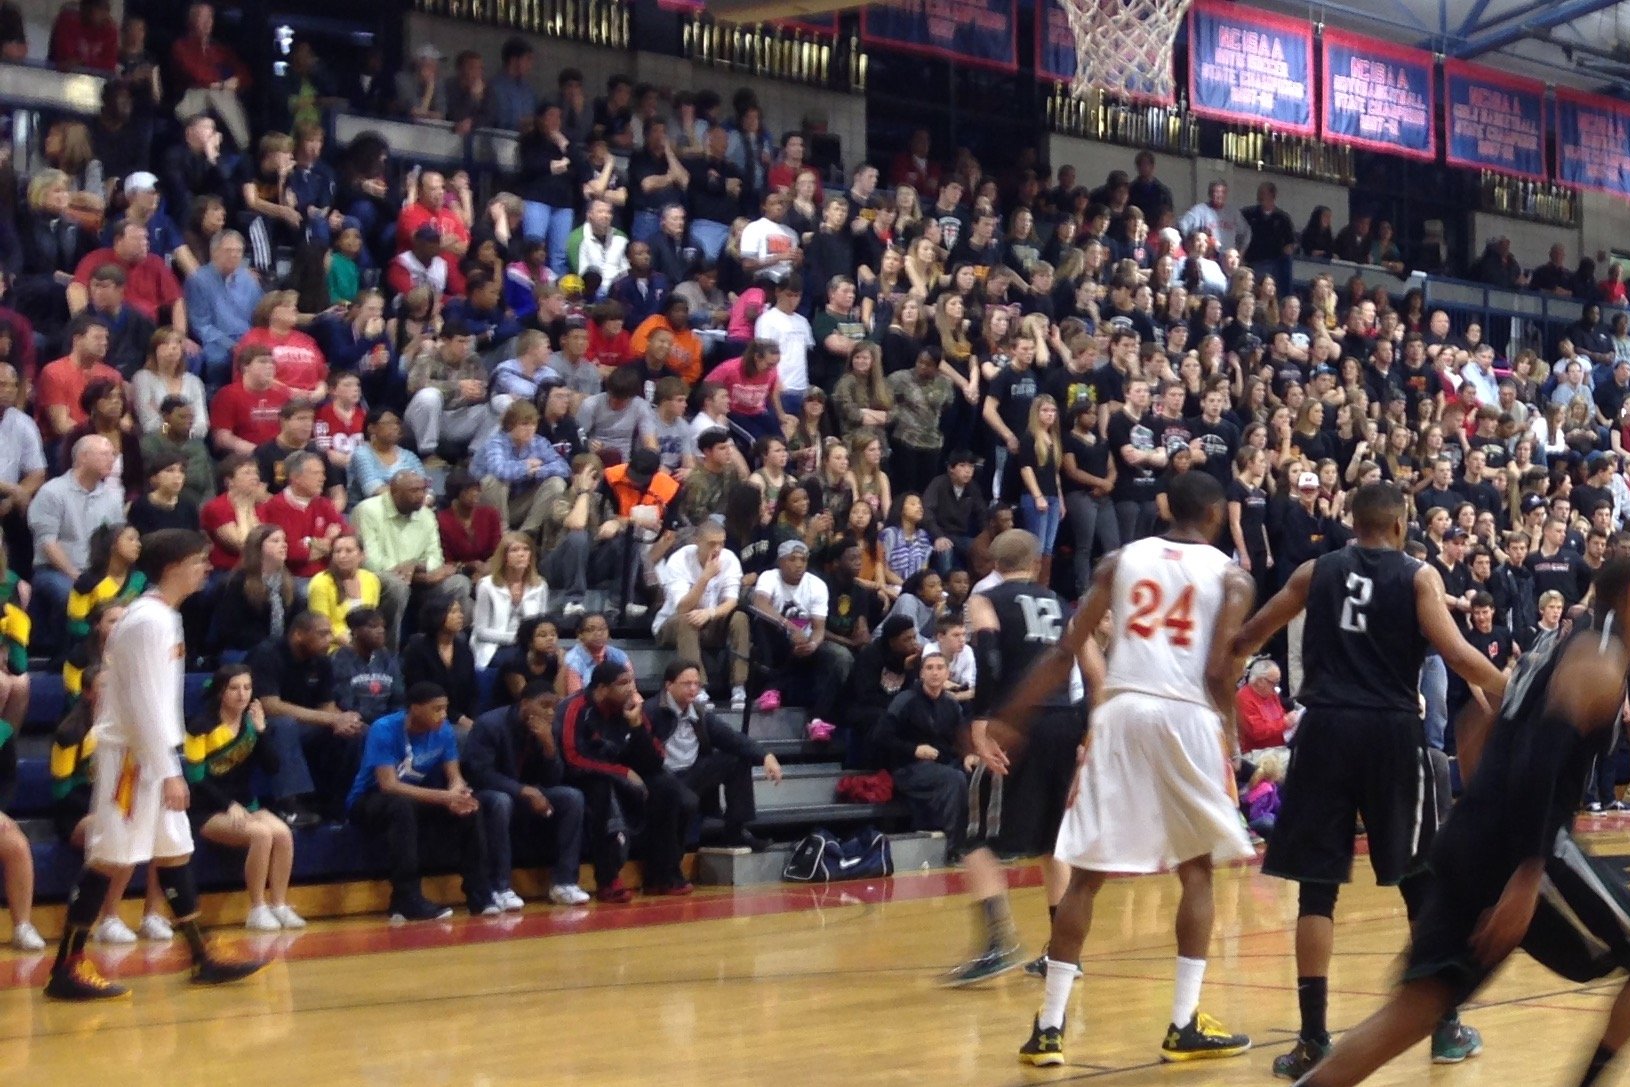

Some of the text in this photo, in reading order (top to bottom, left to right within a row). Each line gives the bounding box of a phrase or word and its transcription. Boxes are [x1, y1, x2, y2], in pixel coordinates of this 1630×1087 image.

[1014, 593, 1063, 645] 12
[1126, 578, 1197, 646] 24
[1339, 571, 1374, 633] 2
